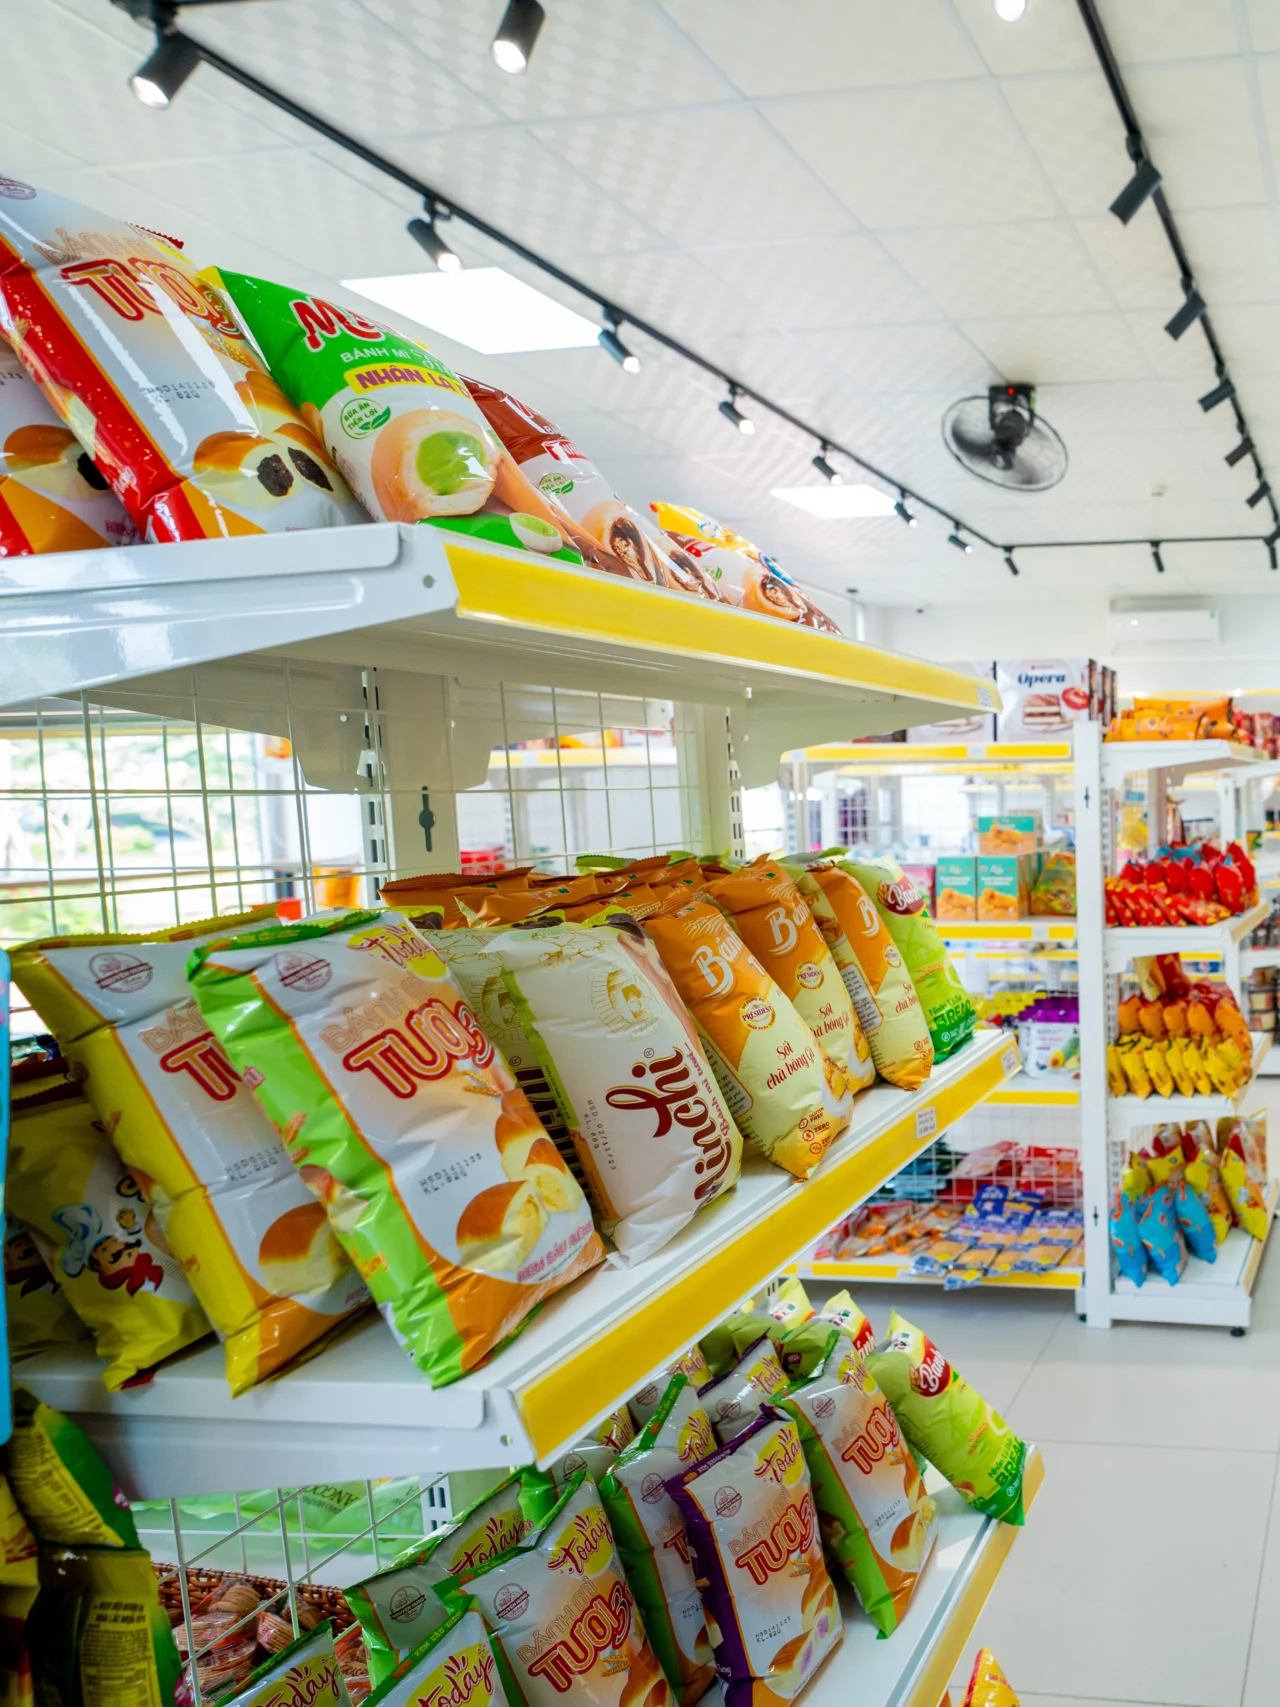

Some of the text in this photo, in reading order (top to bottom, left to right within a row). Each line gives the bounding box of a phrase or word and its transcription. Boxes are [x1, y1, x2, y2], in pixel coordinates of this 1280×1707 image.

[340, 347, 390, 363] BÁNH
[355, 362, 426, 390] NHÂN
[810, 1022, 824, 1039] hà
[776, 1041, 794, 1061] Sốt
[766, 1067, 788, 1090] chà
[789, 1052, 809, 1077] bông
[711, 1102, 731, 1137] Bánh
[814, 1121, 830, 1132] ZERO
[858, 1332, 877, 1359] ánh
[920, 1347, 949, 1392] Bánh
[995, 1437, 1024, 1487] BREA
[517, 1601, 576, 1664] BÁNH
